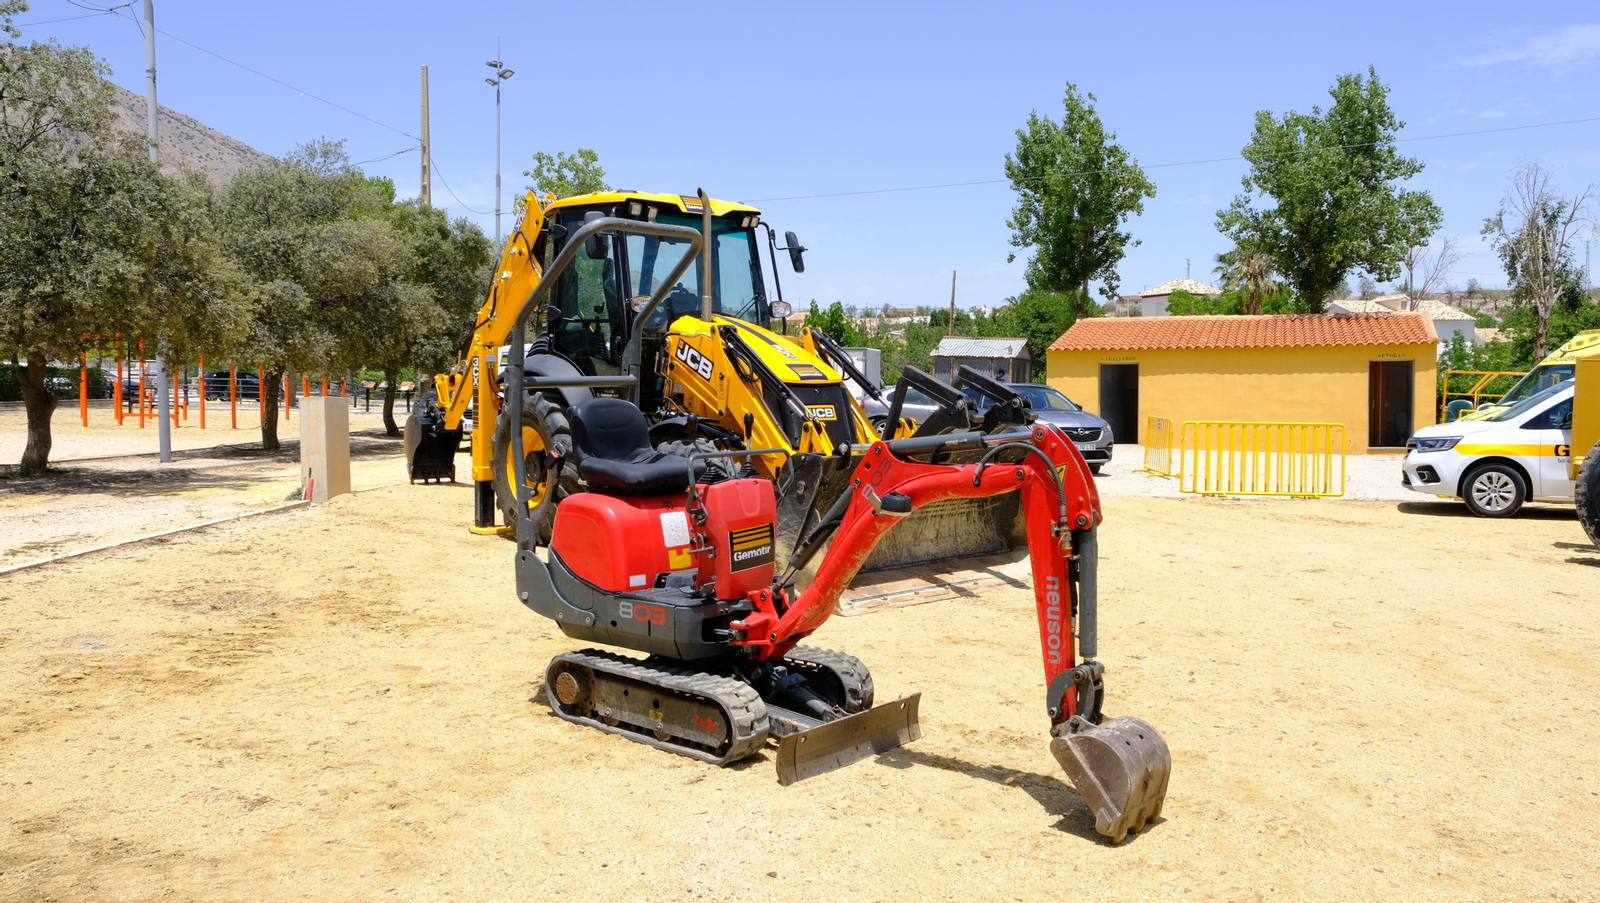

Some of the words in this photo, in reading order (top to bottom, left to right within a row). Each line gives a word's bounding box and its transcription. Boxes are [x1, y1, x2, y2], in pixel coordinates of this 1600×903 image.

[677, 344, 713, 380] JCB
[810, 408, 833, 417] JCB
[733, 545, 771, 561] Gemotir
[619, 601, 667, 626] 803
[1046, 576, 1062, 664] neuson
